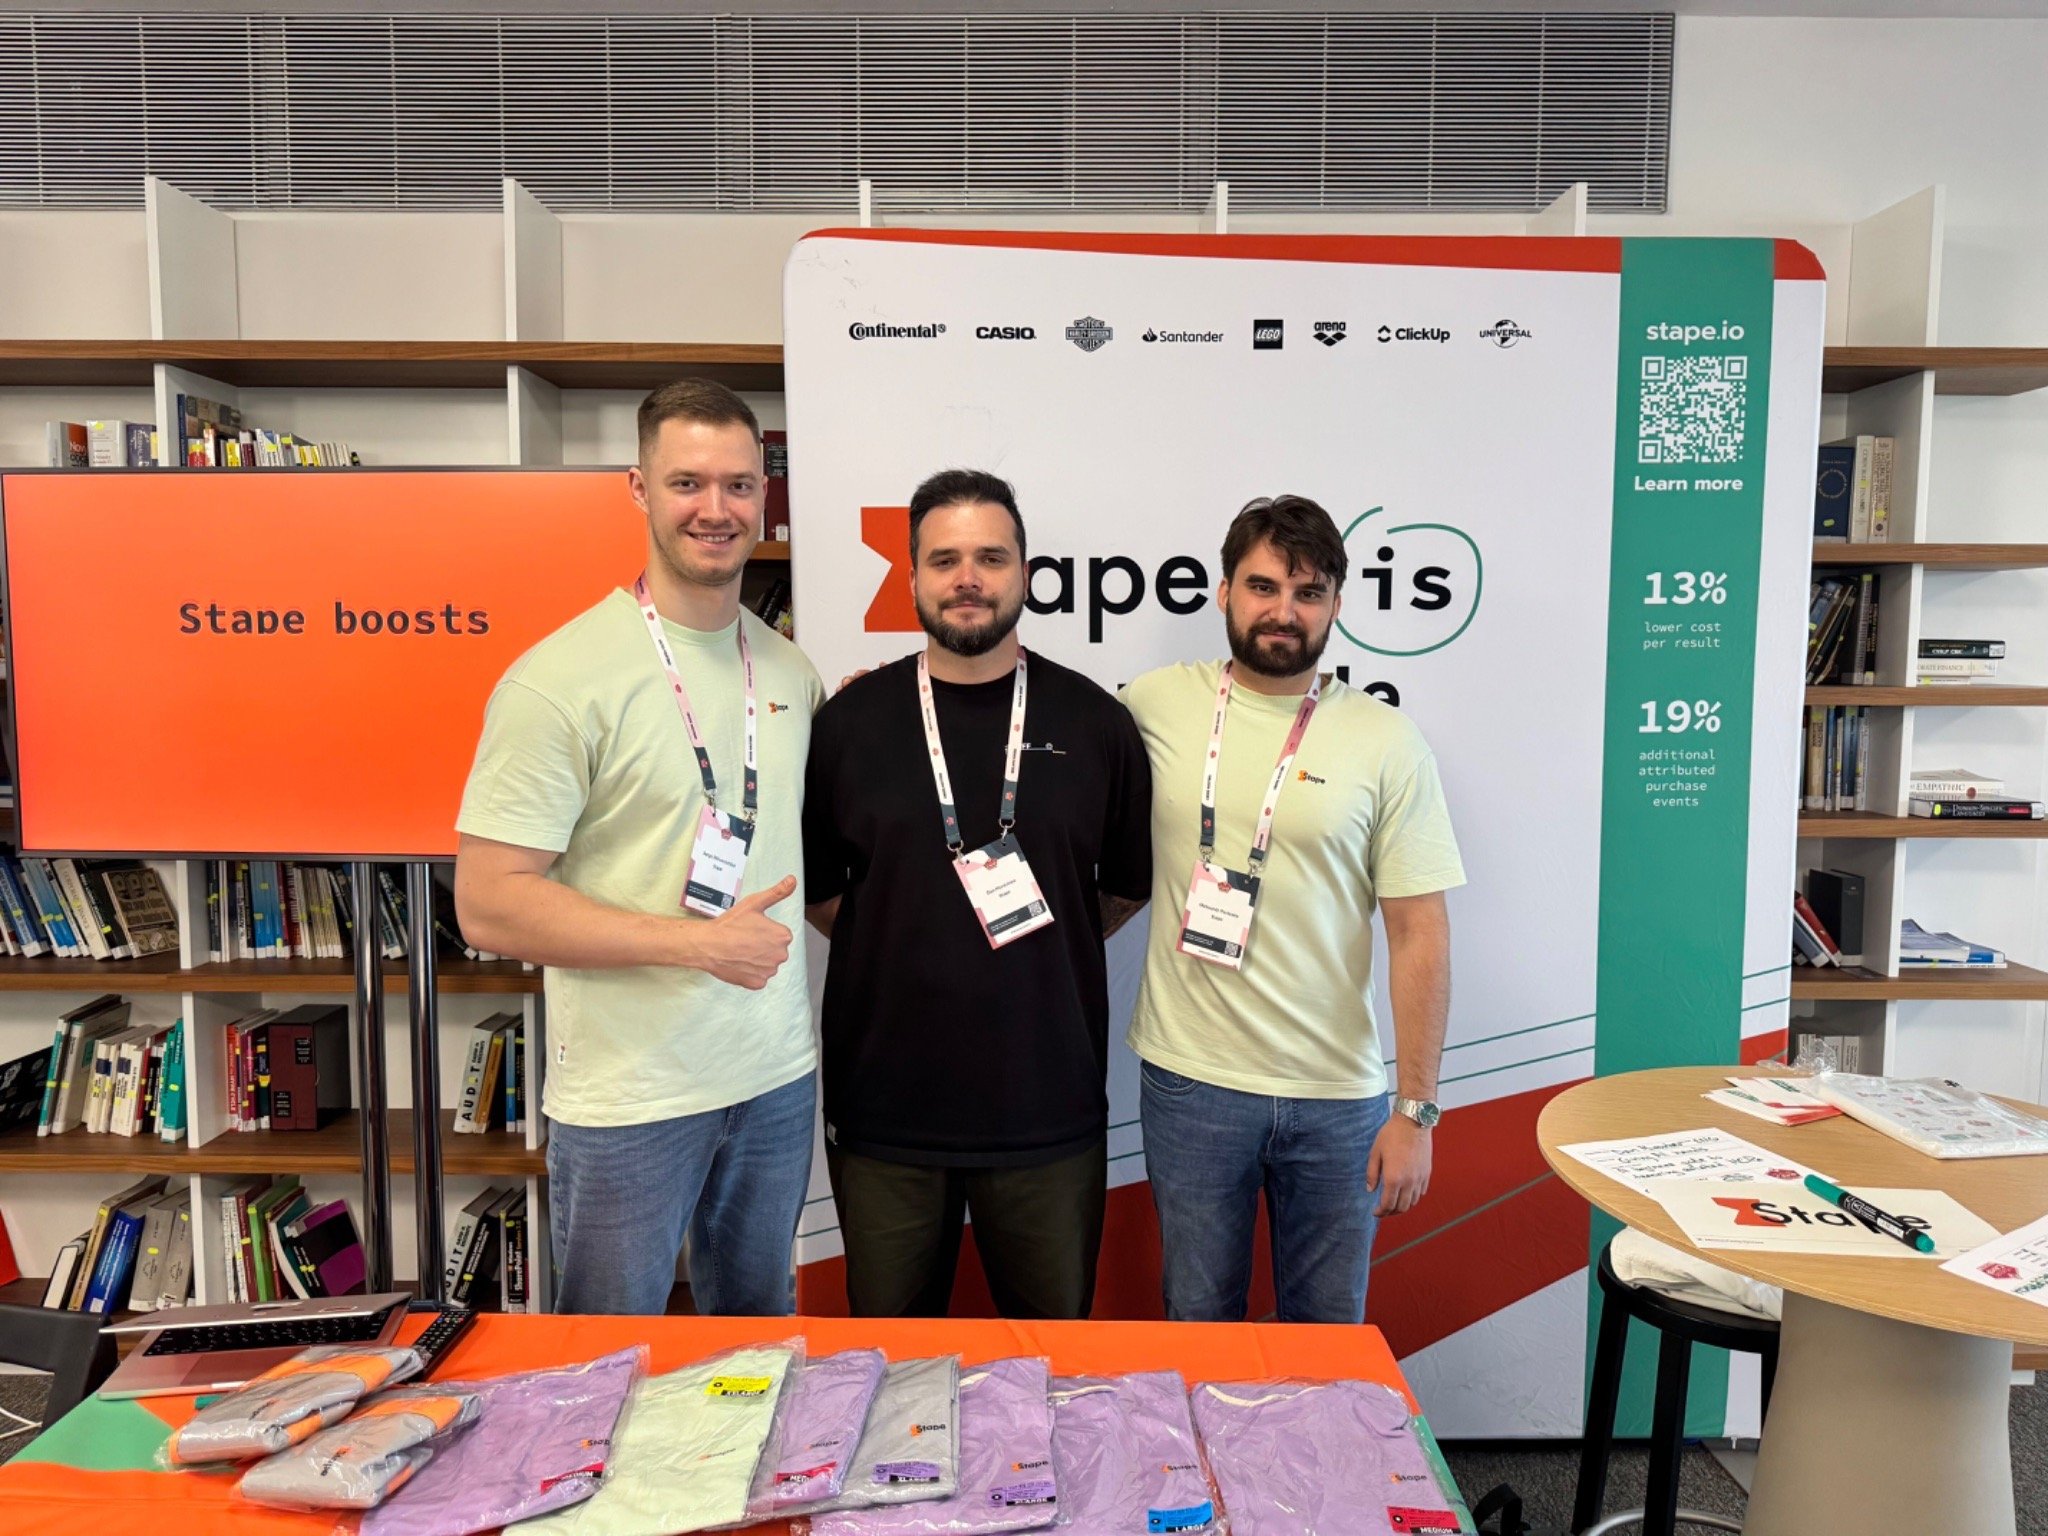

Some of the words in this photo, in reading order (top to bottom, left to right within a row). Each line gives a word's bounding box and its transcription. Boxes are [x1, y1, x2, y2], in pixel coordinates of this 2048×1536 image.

[976, 326, 1036, 340] CASIO
[1314, 321, 1346, 332] arena
[1646, 320, 1745, 346] stape.io
[1160, 330, 1224, 343] Santander
[1255, 327, 1281, 341] LEGO
[1396, 327, 1451, 343] ClickUp
[1479, 329, 1532, 339] UNIVERSAL
[1634, 476, 1687, 490] Learn
[1695, 478, 1743, 490] more
[1362, 546, 1452, 610] is
[1643, 571, 1728, 605] 13%
[1024, 556, 1209, 643] ape
[180, 602, 305, 635] Stape
[334, 601, 490, 635] boosts
[1645, 622, 1682, 633] lower
[1690, 622, 1721, 633] cost
[1643, 638, 1666, 650] per
[1675, 637, 1721, 648] result
[1639, 700, 1722, 733] 19%
[1639, 749, 1716, 760] additional
[1639, 764, 1716, 776] attributed
[1646, 780, 1707, 792] purchase
[1653, 797, 1699, 807] events
[1751, 1201, 1932, 1234] Stae
